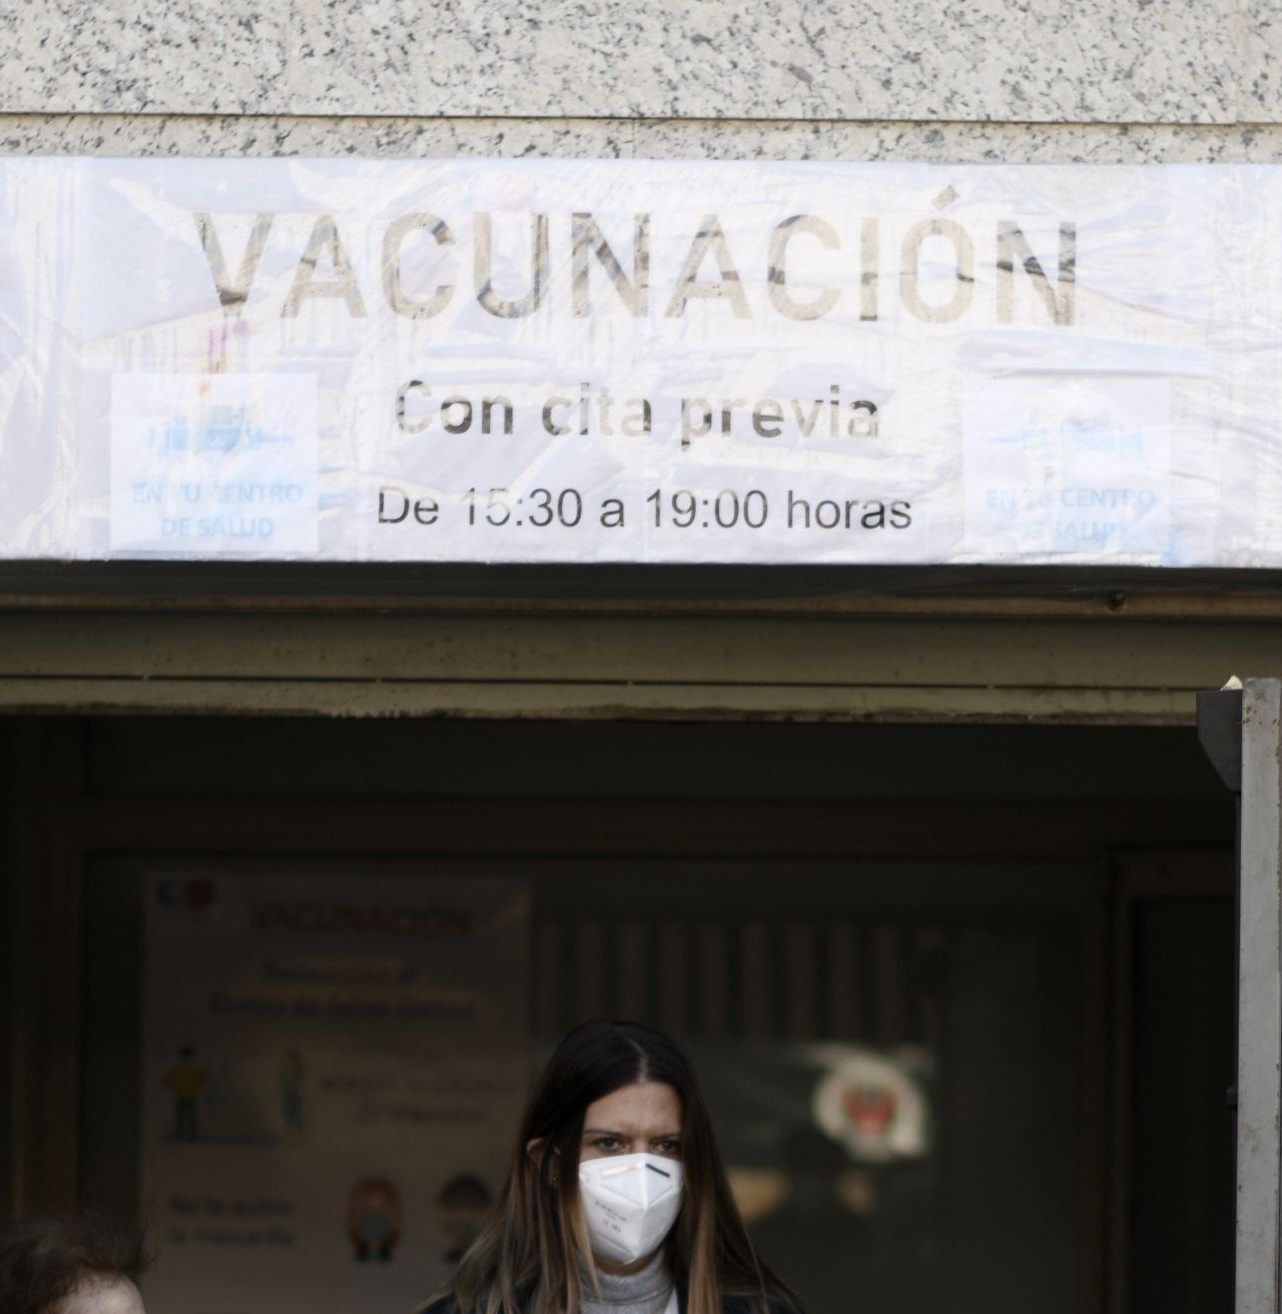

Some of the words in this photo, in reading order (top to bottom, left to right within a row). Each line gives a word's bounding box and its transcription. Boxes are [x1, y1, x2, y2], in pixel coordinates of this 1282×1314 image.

[191, 184, 1077, 327] VACUNACIÓN
[395, 379, 515, 436] Con
[541, 381, 653, 437] cita
[680, 384, 880, 451] previa
[132, 482, 163, 504] EN
[168, 482, 201, 503] U
[377, 490, 439, 526] De
[464, 487, 583, 527] 15:30
[599, 499, 625, 528] a
[646, 488, 769, 529] 19:00
[786, 488, 913, 529] horas
[161, 517, 191, 538] DE
[198, 516, 275, 539] SALUD
